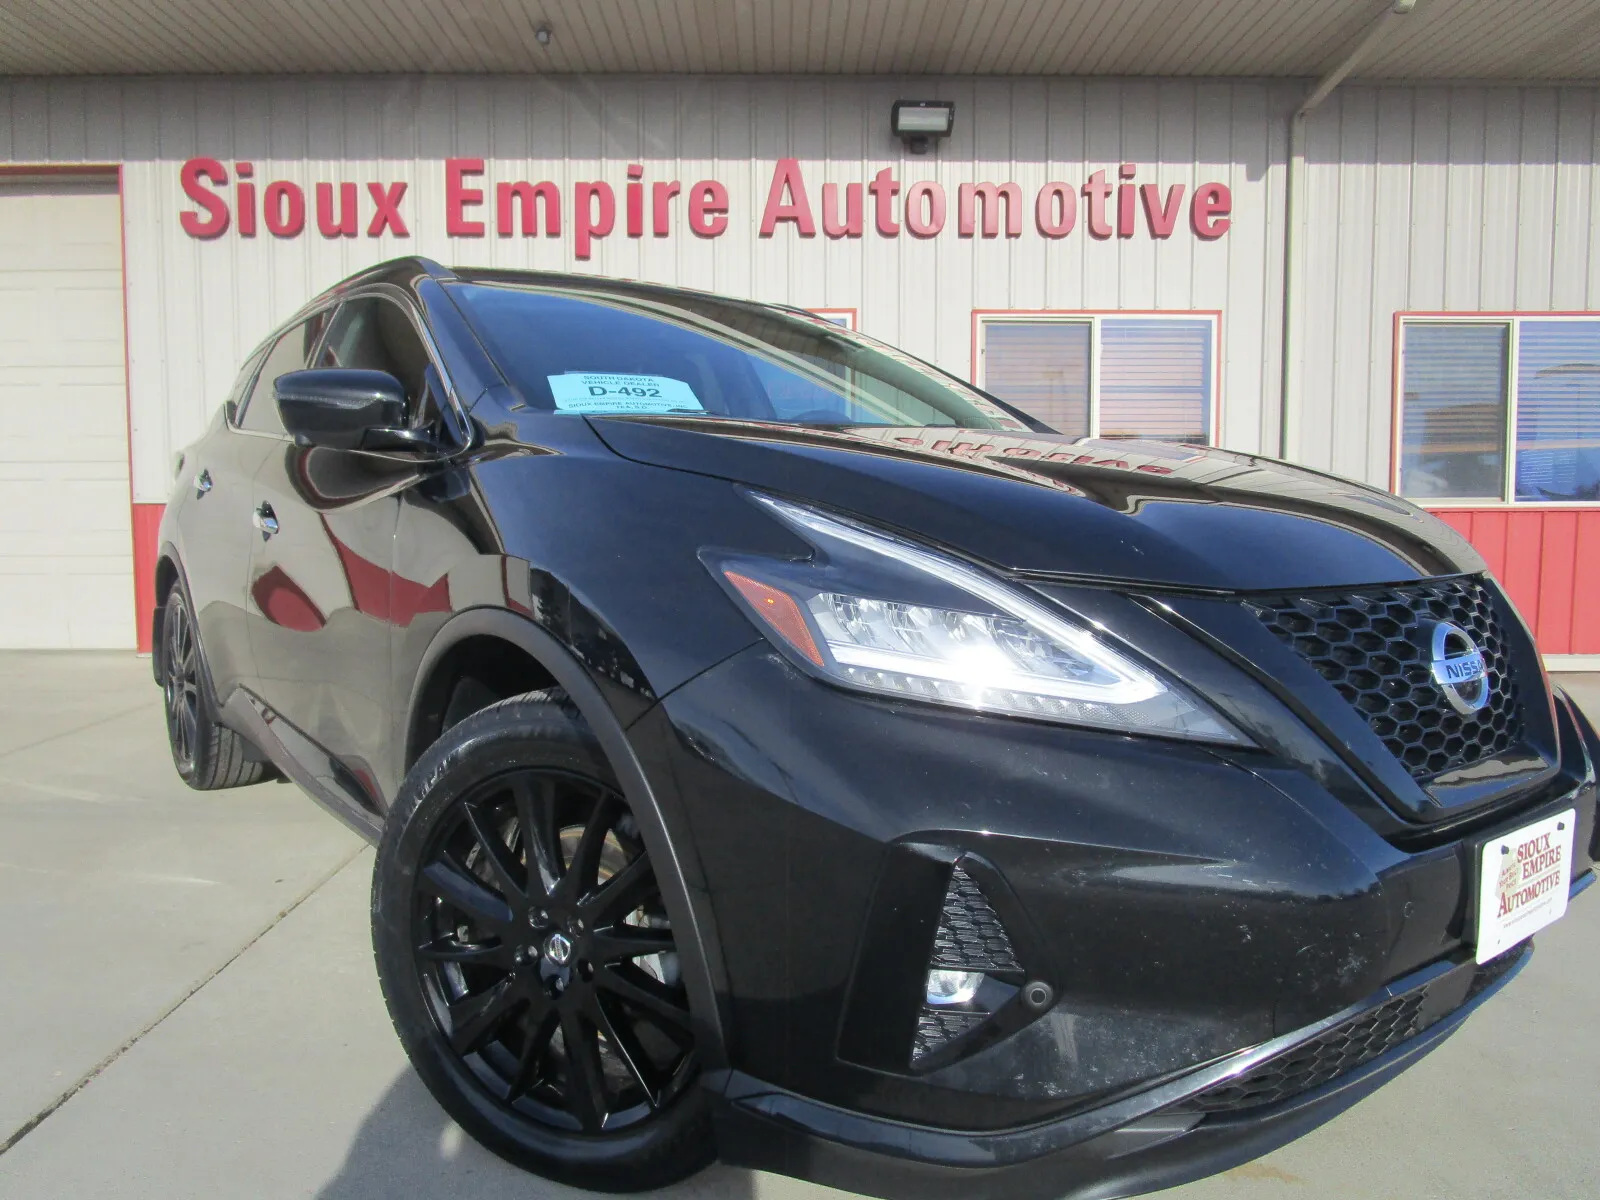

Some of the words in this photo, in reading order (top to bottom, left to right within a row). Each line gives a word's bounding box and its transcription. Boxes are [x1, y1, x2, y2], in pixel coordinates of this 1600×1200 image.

[180, 156, 410, 238] Sioux
[445, 157, 729, 259] Empire
[759, 157, 1232, 239] Automotive
[588, 386, 662, 398] D-492
[1446, 660, 1482, 679] NISSA
[1517, 832, 1550, 863] SIOUX
[1522, 845, 1561, 880] EMPIRE
[1497, 870, 1560, 918] AUTOMOTIVE
